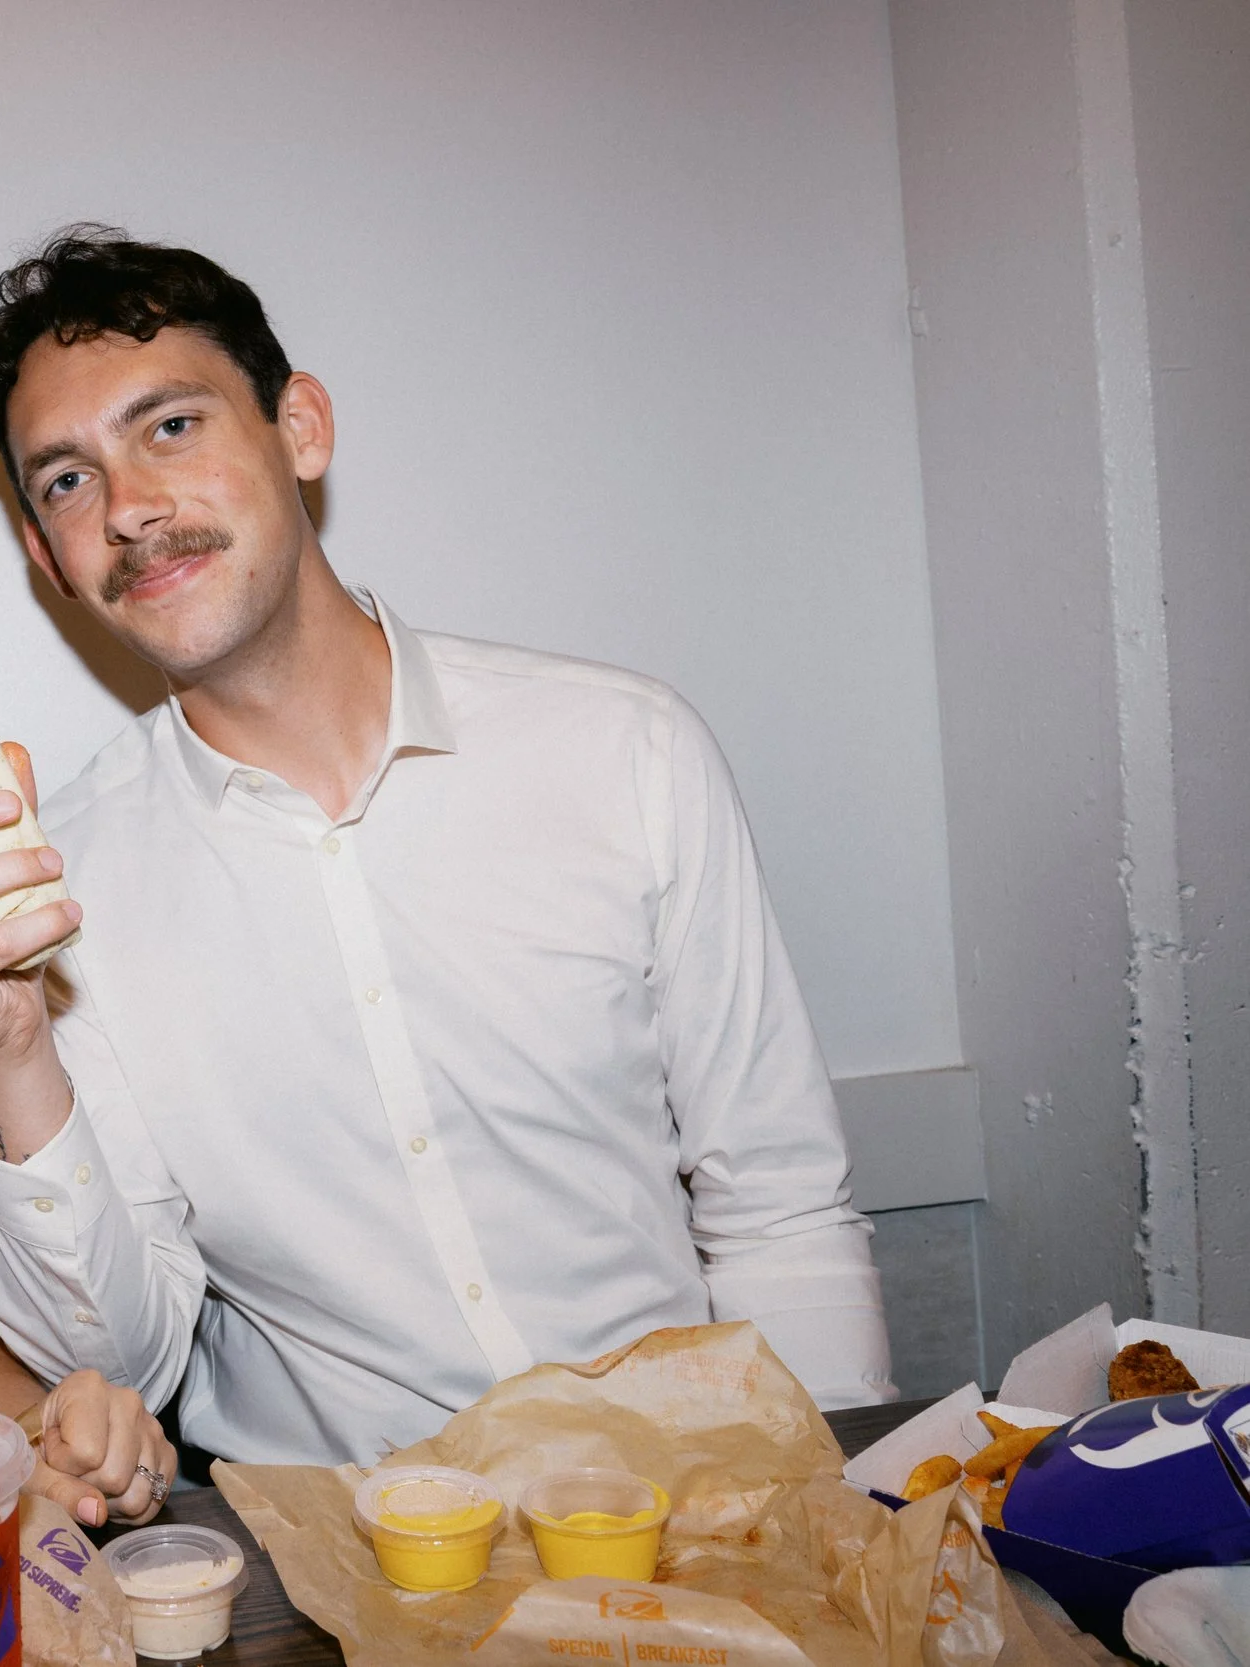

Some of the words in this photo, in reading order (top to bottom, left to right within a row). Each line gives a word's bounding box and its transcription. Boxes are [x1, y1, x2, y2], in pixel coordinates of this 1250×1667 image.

[27, 1566, 82, 1613] SUPREME.
[548, 1637, 614, 1659] SPECIAL
[636, 1643, 730, 1667] BREAKFAST
